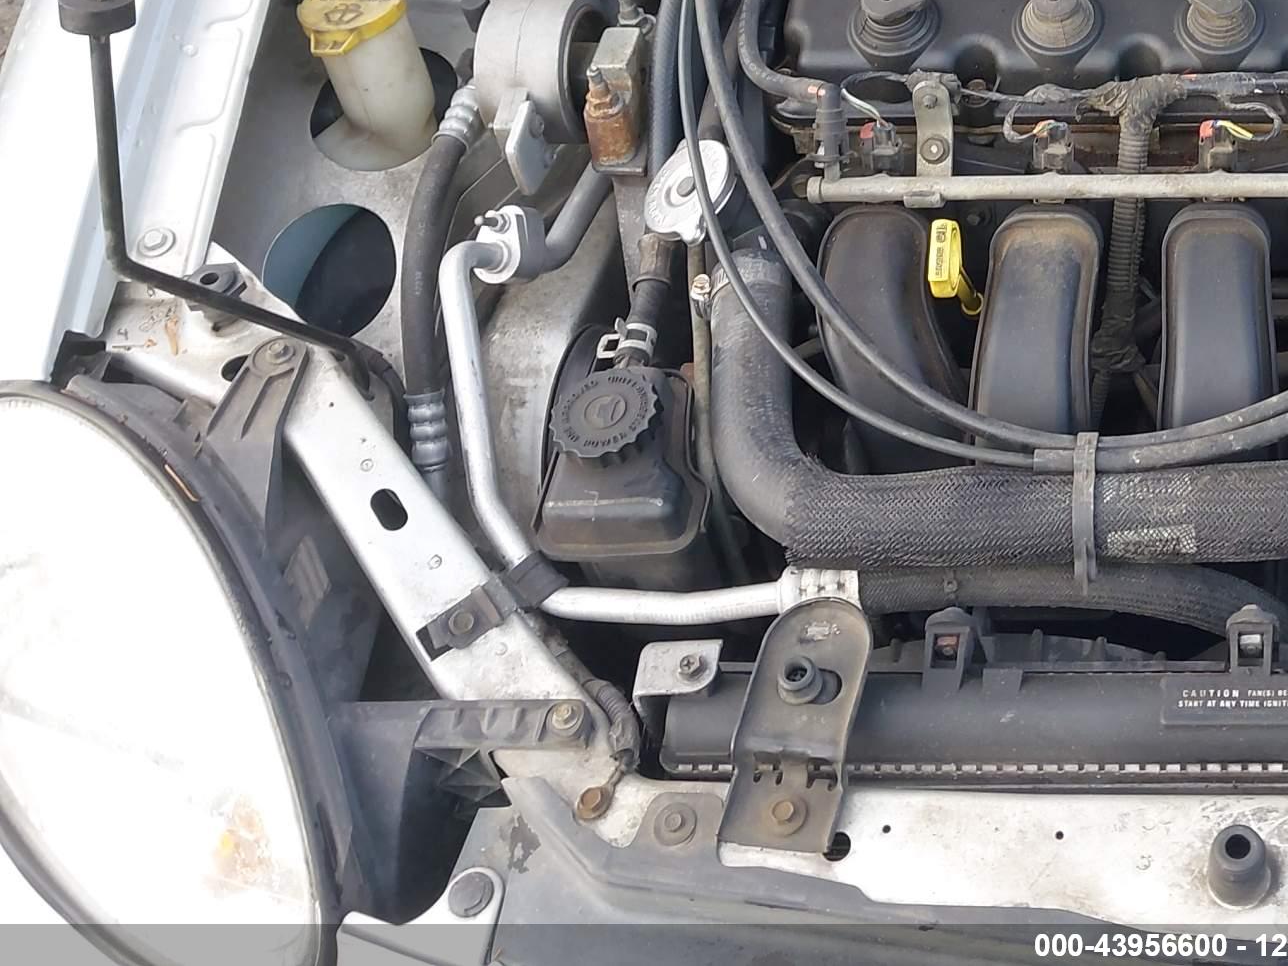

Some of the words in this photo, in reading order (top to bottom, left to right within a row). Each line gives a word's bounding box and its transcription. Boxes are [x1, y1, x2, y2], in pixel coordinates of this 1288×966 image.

[1182, 689, 1240, 698] CAUTION
[1247, 689, 1275, 698] FAN(S)
[1178, 700, 1203, 708] START
[1219, 700, 1236, 708] ANY
[1239, 700, 1260, 708] TIME
